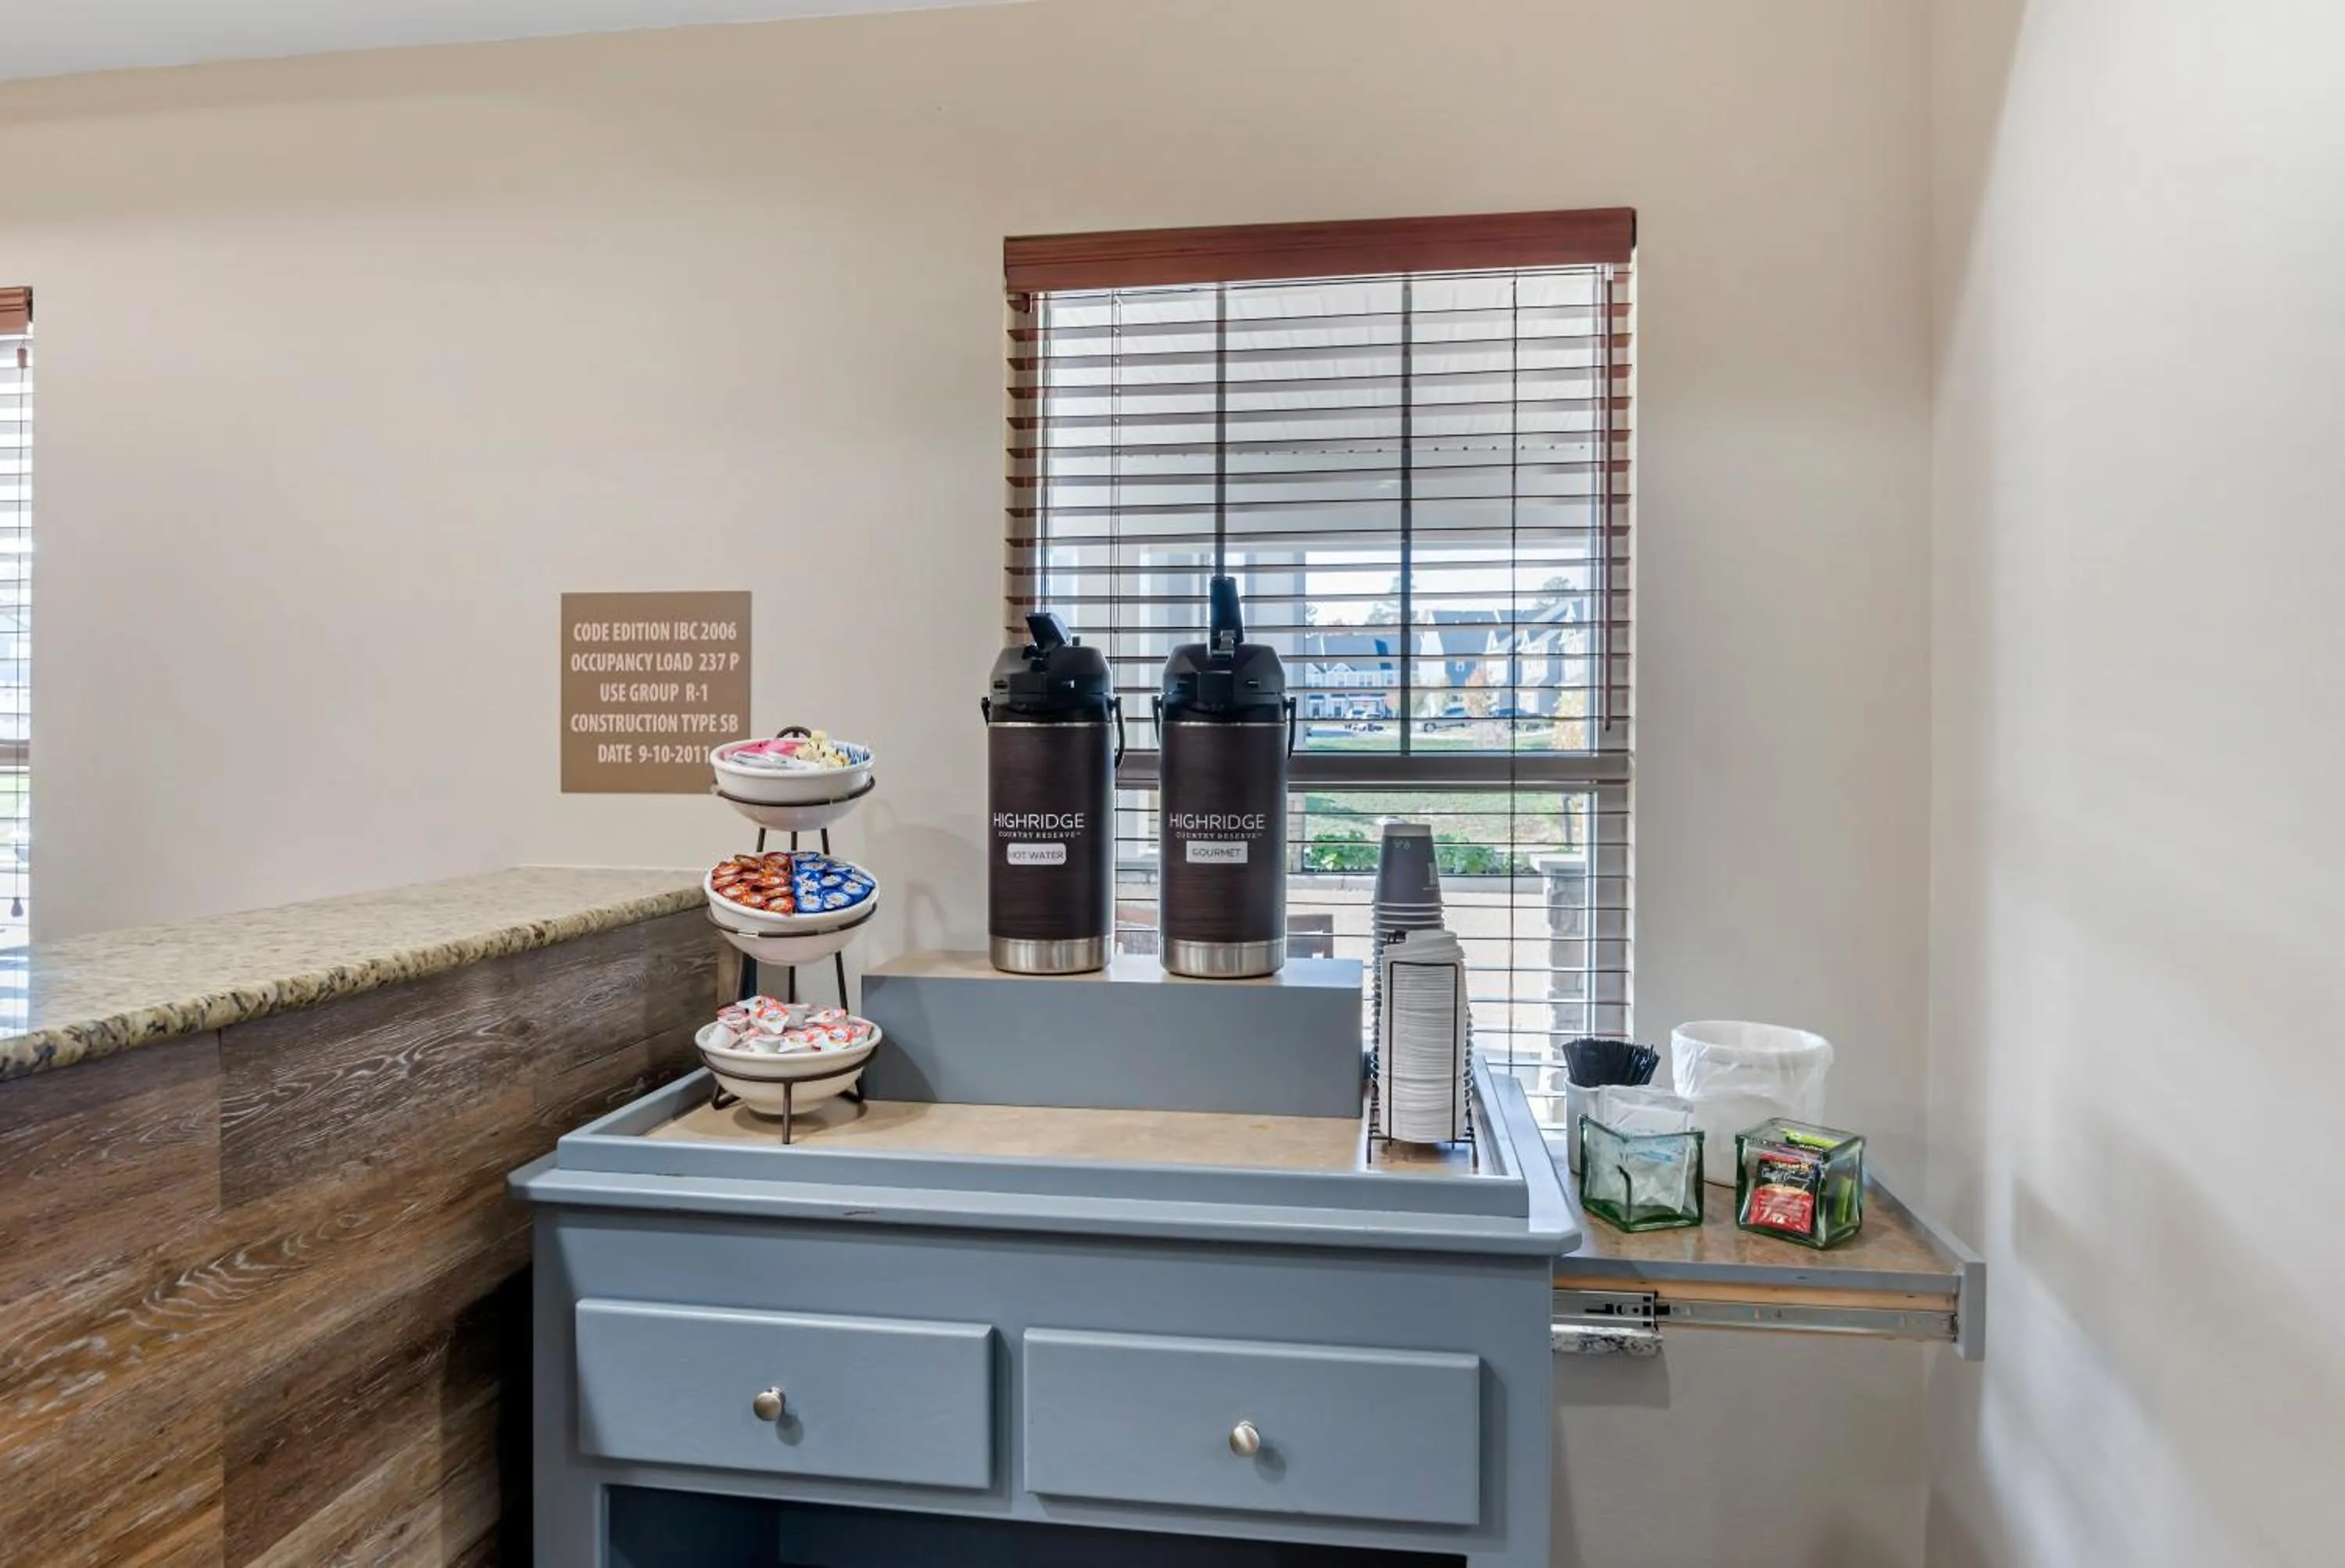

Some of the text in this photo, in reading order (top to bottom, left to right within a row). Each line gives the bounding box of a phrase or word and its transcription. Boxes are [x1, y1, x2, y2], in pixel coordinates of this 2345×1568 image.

[574, 622, 737, 642] CODE EDITION IBC 2006
[571, 653, 740, 671] OCCUPANCY LOAD 237 P
[600, 683, 708, 702] USE GROUP R-1
[571, 714, 678, 732] CONSTRUCTION
[681, 714, 717, 732] TYPE
[598, 745, 710, 764] DATE 9-10-2011
[993, 812, 1085, 829] HIGHRIDGE
[1169, 813, 1266, 829] HIGHRIDGE
[1029, 850, 1064, 860] WATER
[1192, 848, 1241, 857] GOURMET
